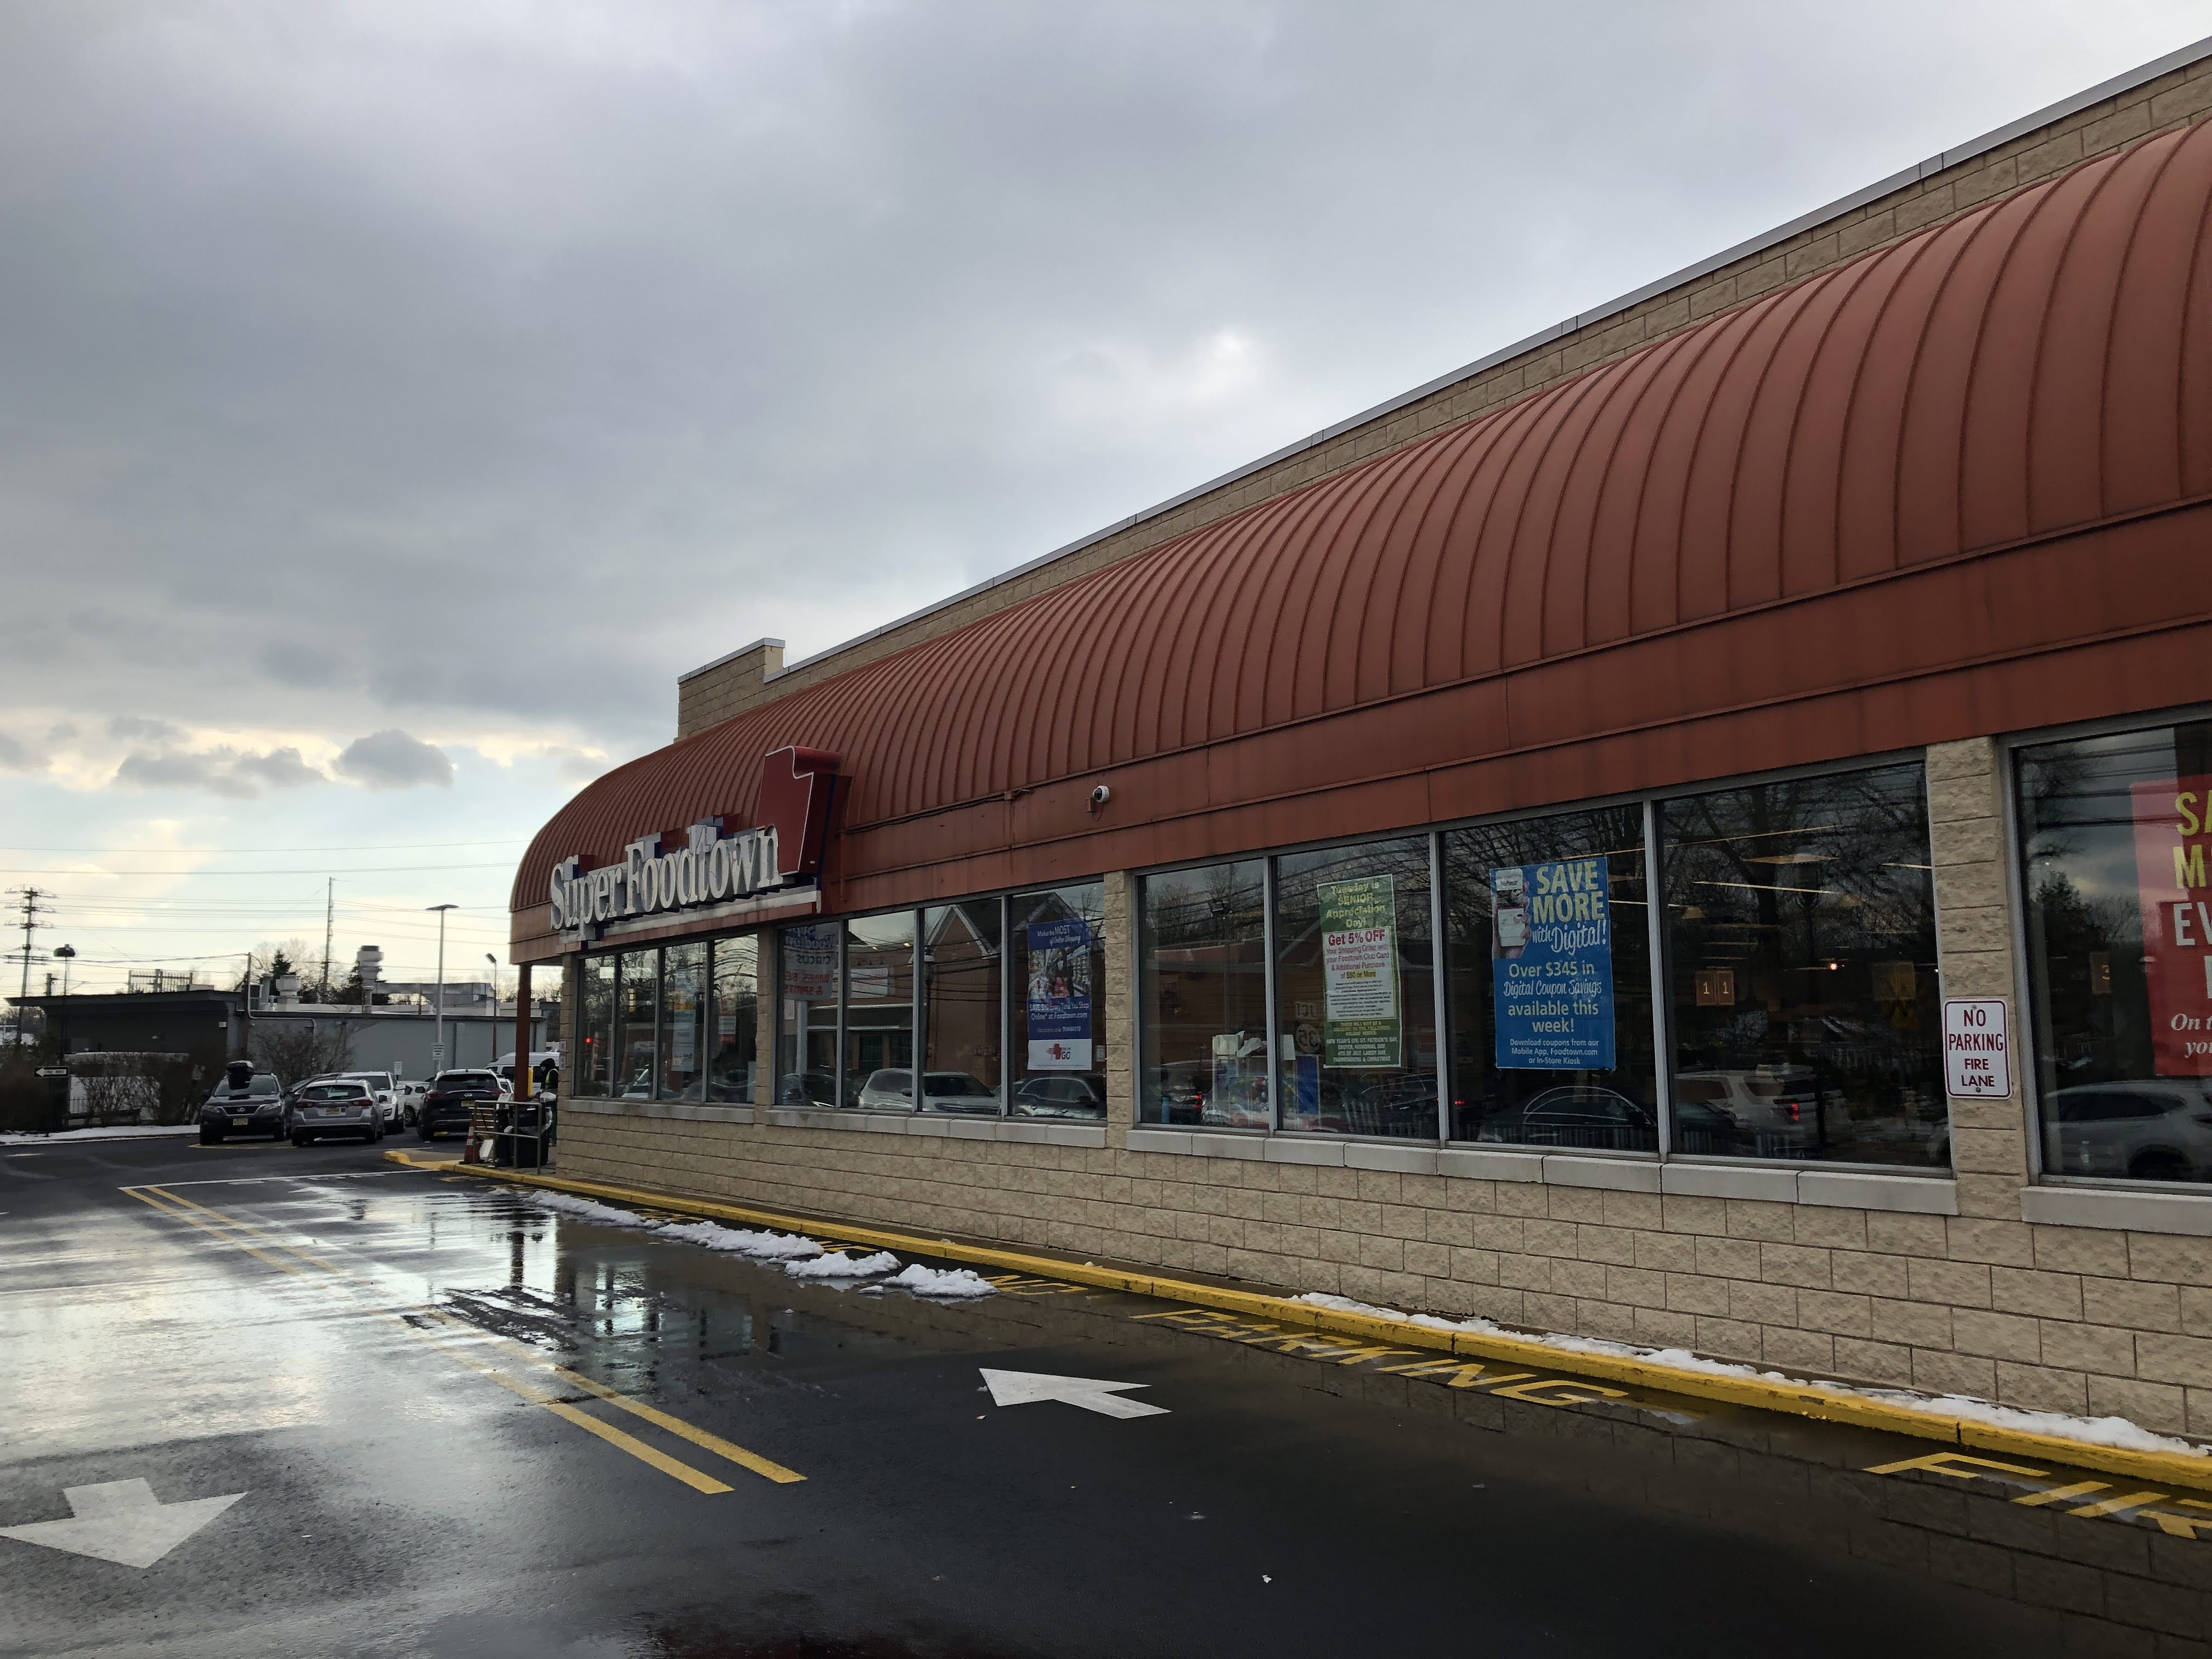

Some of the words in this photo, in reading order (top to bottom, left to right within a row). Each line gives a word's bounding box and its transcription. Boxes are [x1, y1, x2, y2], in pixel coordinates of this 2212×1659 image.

[550, 855, 623, 940] Super
[625, 824, 783, 914] Foodtown
[1537, 861, 1598, 894] SAVE
[1338, 892, 1374, 905] SENIOR
[1533, 891, 1604, 924] MORE
[1326, 905, 1385, 919] Appreciation
[1329, 934, 1345, 946] Get
[1348, 932, 1363, 944] 5%
[1365, 929, 1385, 943] OFF
[1532, 925, 1553, 943] with
[1551, 919, 1606, 956] Digital!
[1509, 963, 1542, 977] Over
[1545, 961, 1578, 978] $345
[1582, 960, 1595, 975] in
[1503, 980, 1534, 998] Digital
[1536, 980, 1567, 998] Coupon
[1568, 978, 1602, 997] Savings
[1508, 1000, 1568, 1016] available
[1572, 1000, 1599, 1015] this
[1532, 1018, 1574, 1032] week!
[1963, 1009, 1986, 1027] NO
[2171, 1013, 2201, 1030] On
[1949, 1034, 2004, 1052] PARKING
[1965, 1058, 1989, 1070] FIRE
[1961, 1075, 1995, 1087] LANE
[1129, 1309, 1629, 1406] PARKING
